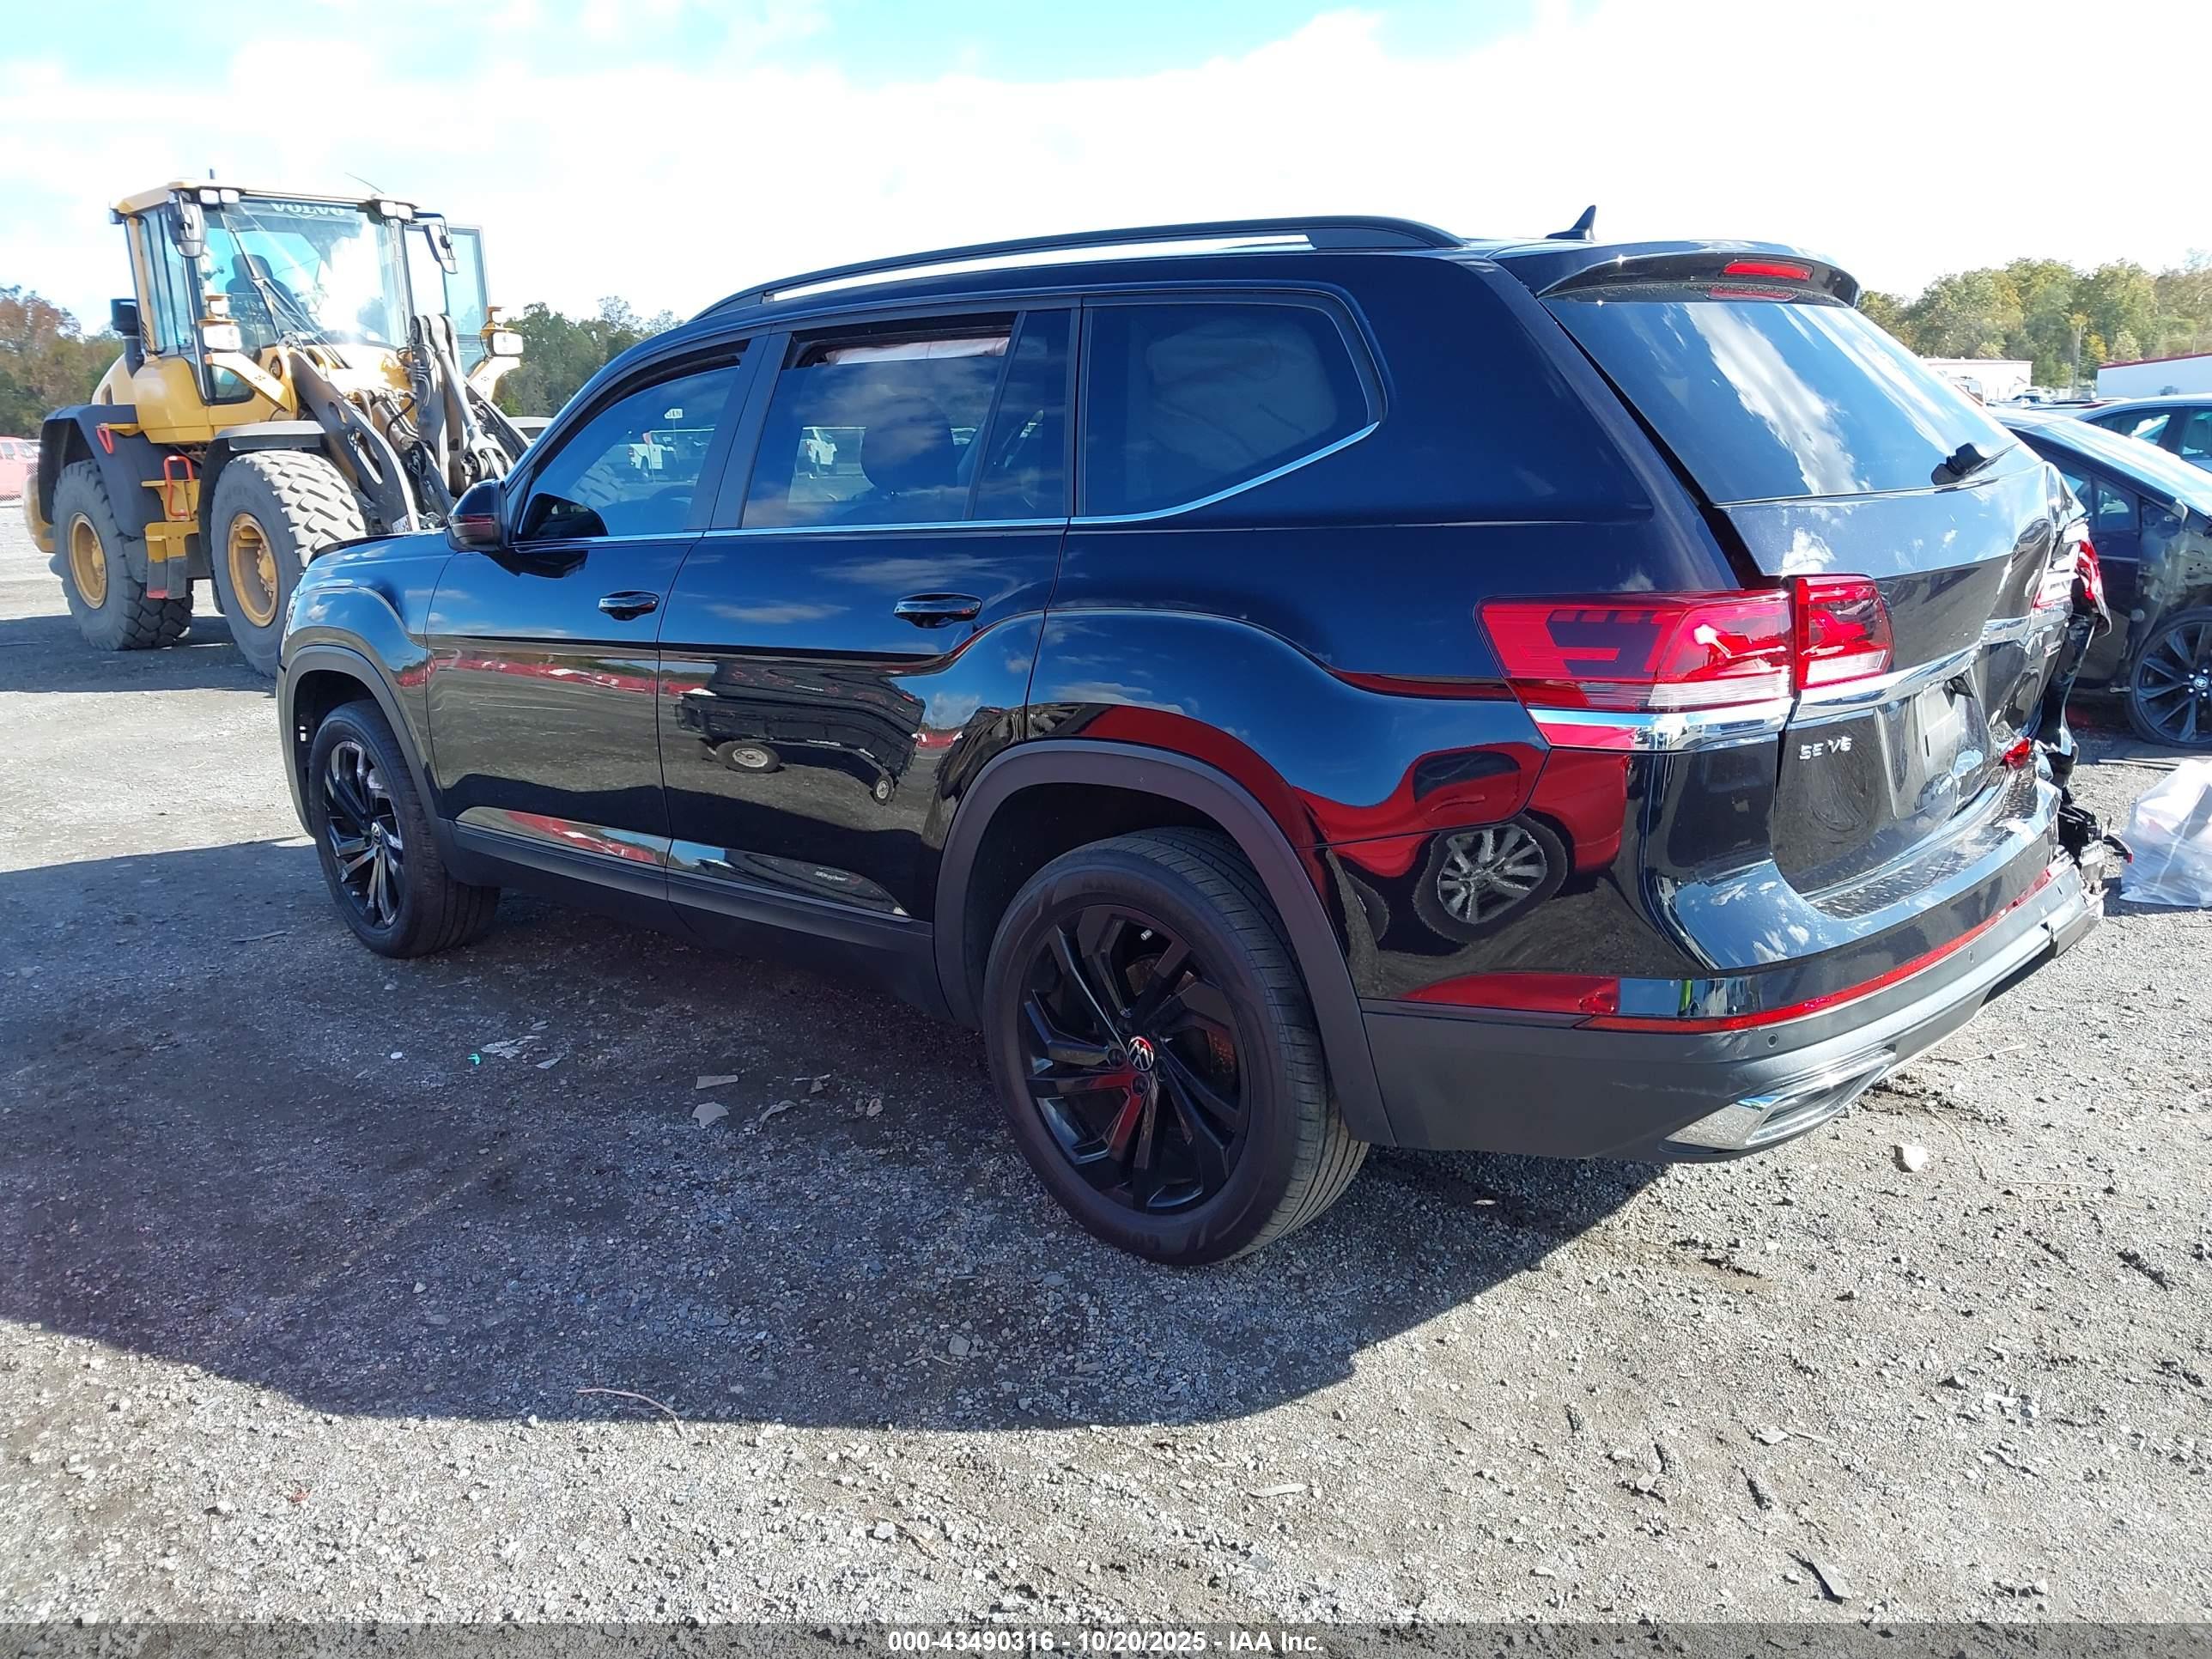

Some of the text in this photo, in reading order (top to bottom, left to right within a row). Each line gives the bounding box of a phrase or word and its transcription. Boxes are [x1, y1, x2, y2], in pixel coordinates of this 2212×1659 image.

[270, 203, 345, 216] VOLVO
[1799, 736, 1852, 760] SE V6
